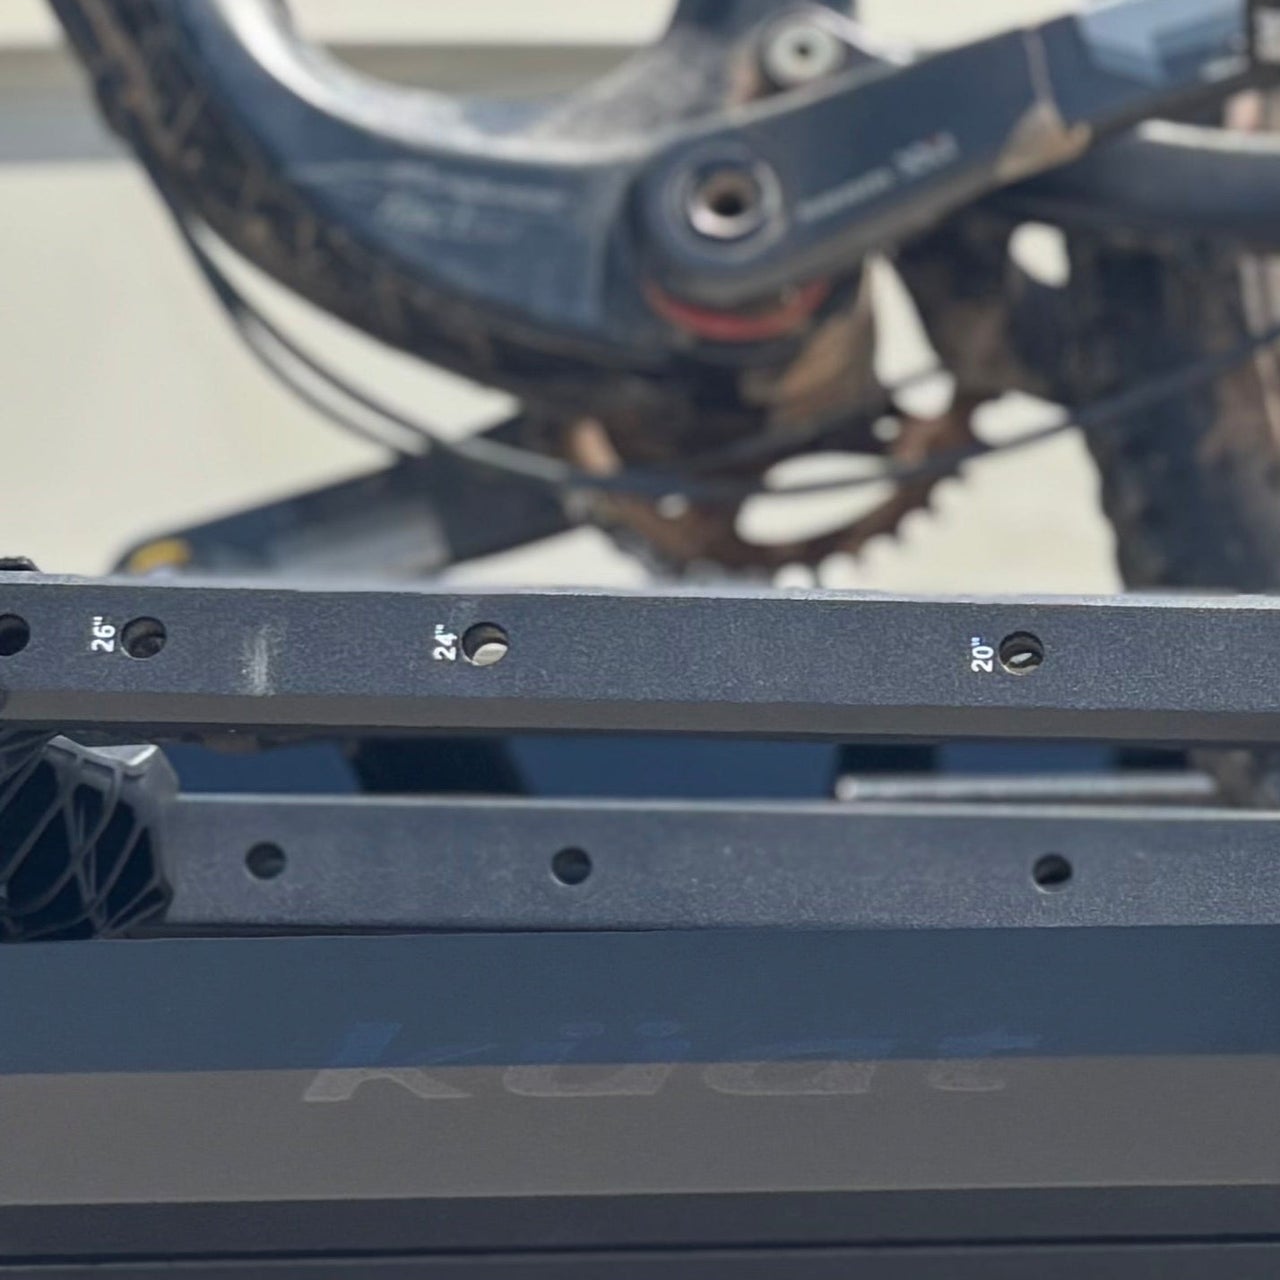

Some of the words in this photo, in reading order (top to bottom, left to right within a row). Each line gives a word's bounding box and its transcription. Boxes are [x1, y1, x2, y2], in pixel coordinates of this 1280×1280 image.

[90, 615, 116, 653] 26"
[432, 623, 458, 661] 24"
[970, 636, 994, 673] 20"
